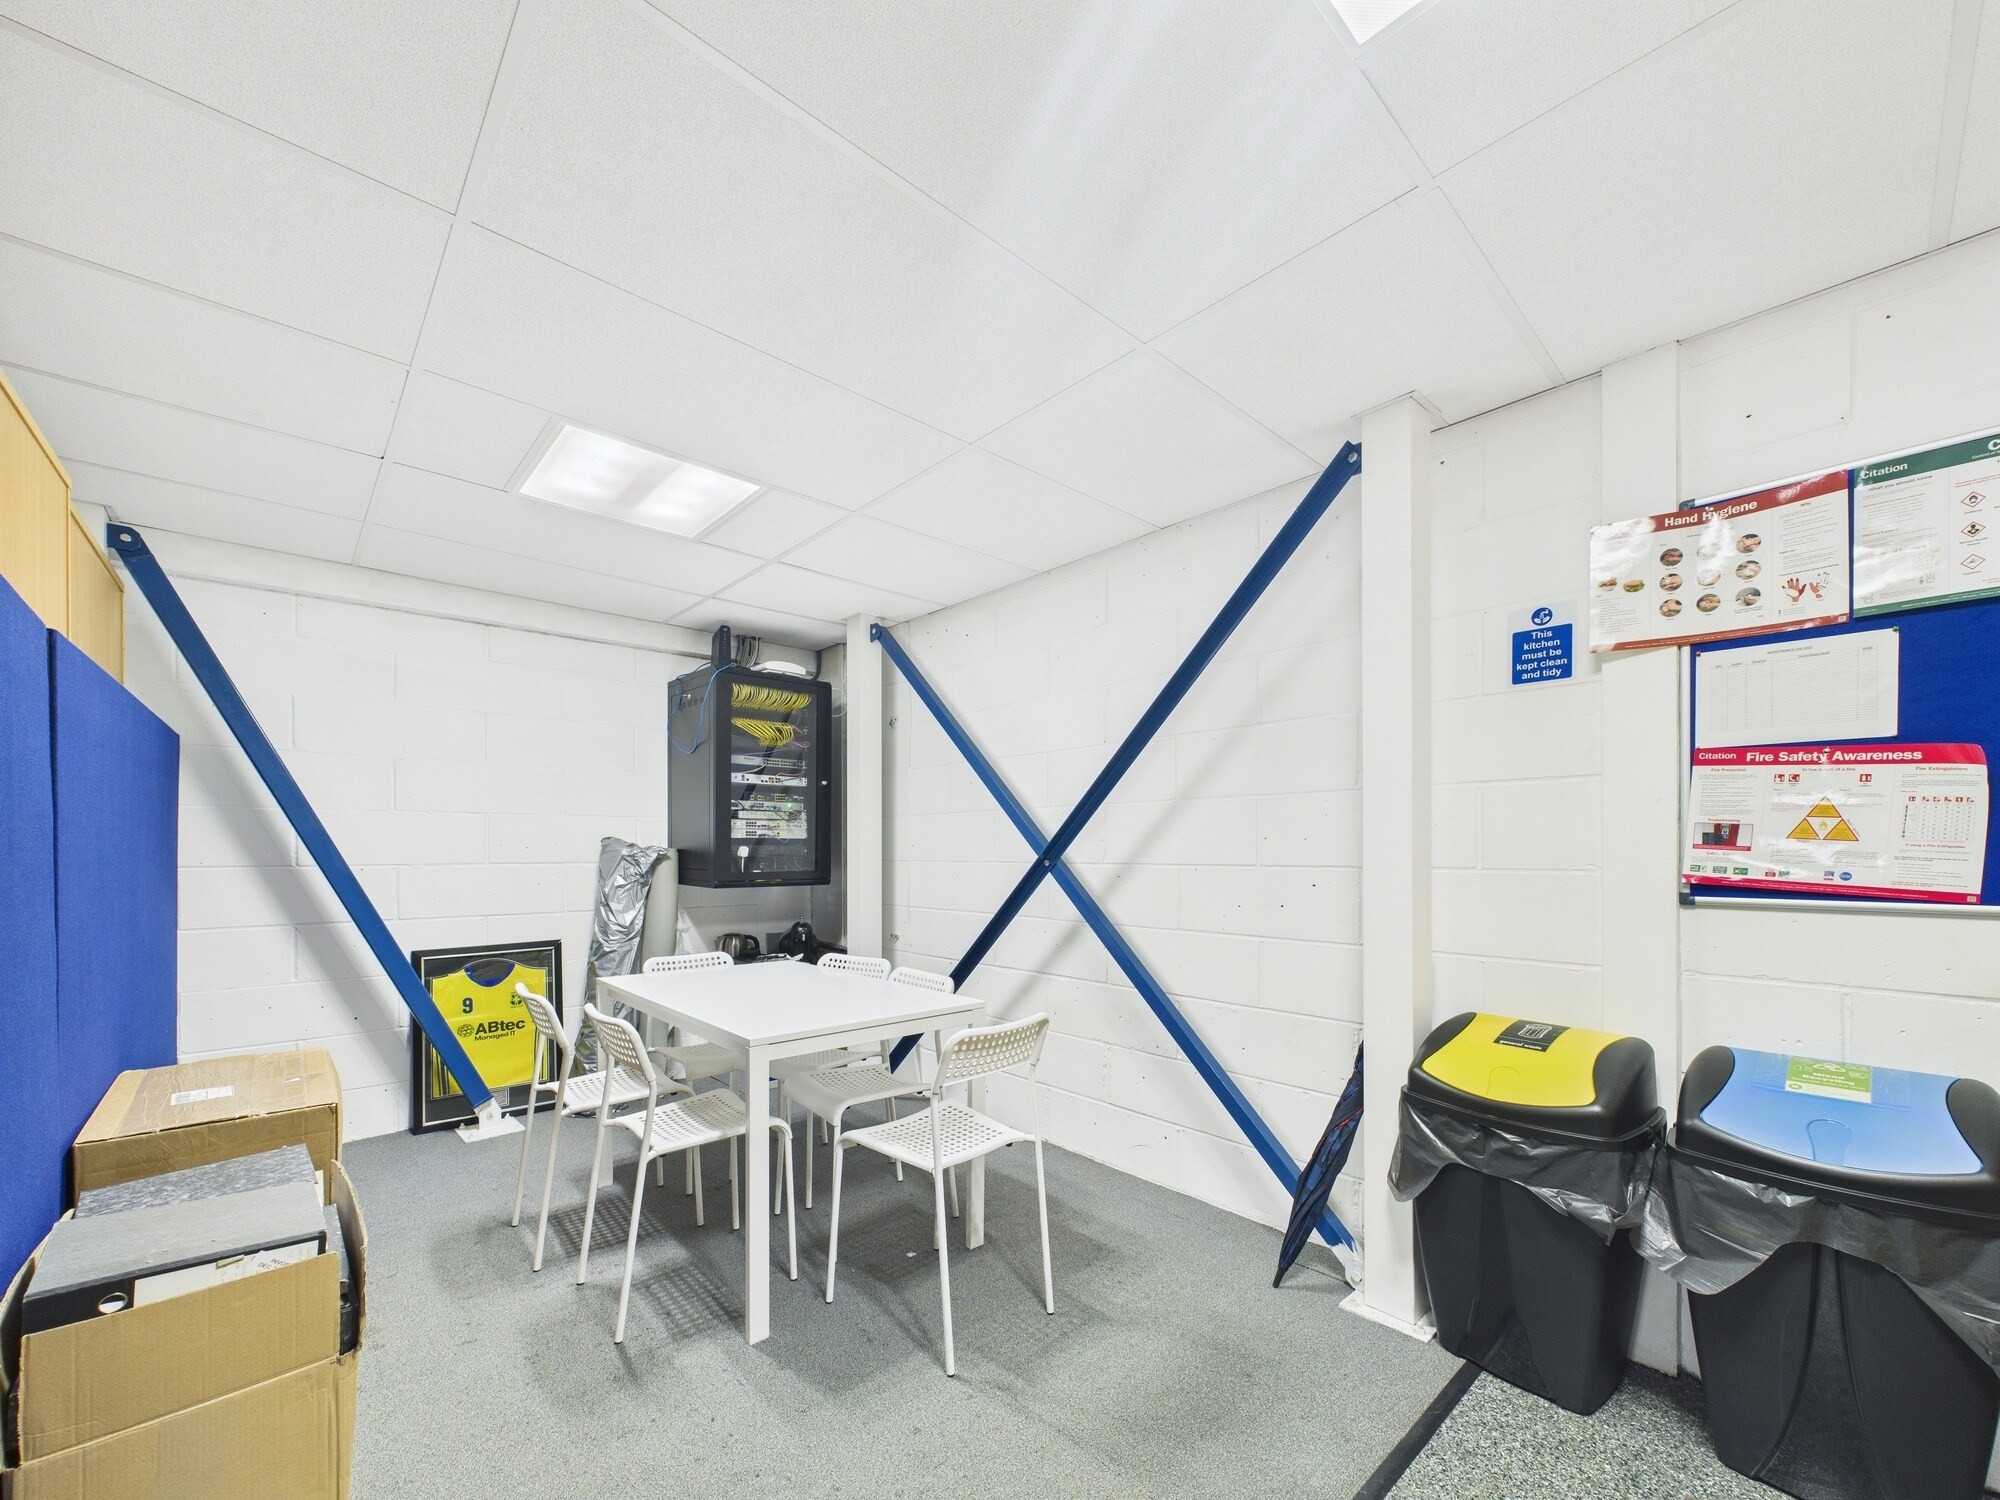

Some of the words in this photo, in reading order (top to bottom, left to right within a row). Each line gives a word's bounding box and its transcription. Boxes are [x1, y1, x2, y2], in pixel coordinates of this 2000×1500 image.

[1860, 463, 1908, 479] Citation
[1664, 513, 1698, 527] Hand
[1702, 501, 1758, 521] Hygiene
[1531, 630, 1553, 640] This
[1523, 639, 1560, 651] kitchen
[1521, 650, 1547, 660] must
[1516, 661, 1538, 671] kept
[1540, 658, 1568, 668] clean
[1521, 670, 1540, 680] and
[1542, 668, 1562, 677] tidy
[1698, 752, 1737, 760] Citation
[1746, 752, 1774, 762] Fire
[1778, 751, 1828, 763] Safety
[1832, 750, 1923, 761] Awareness
[462, 997, 474, 1014] 9
[475, 1020, 526, 1035] ABtec
[474, 1031, 509, 1041] Managed
[1802, 1074, 1855, 1085] Recycling
